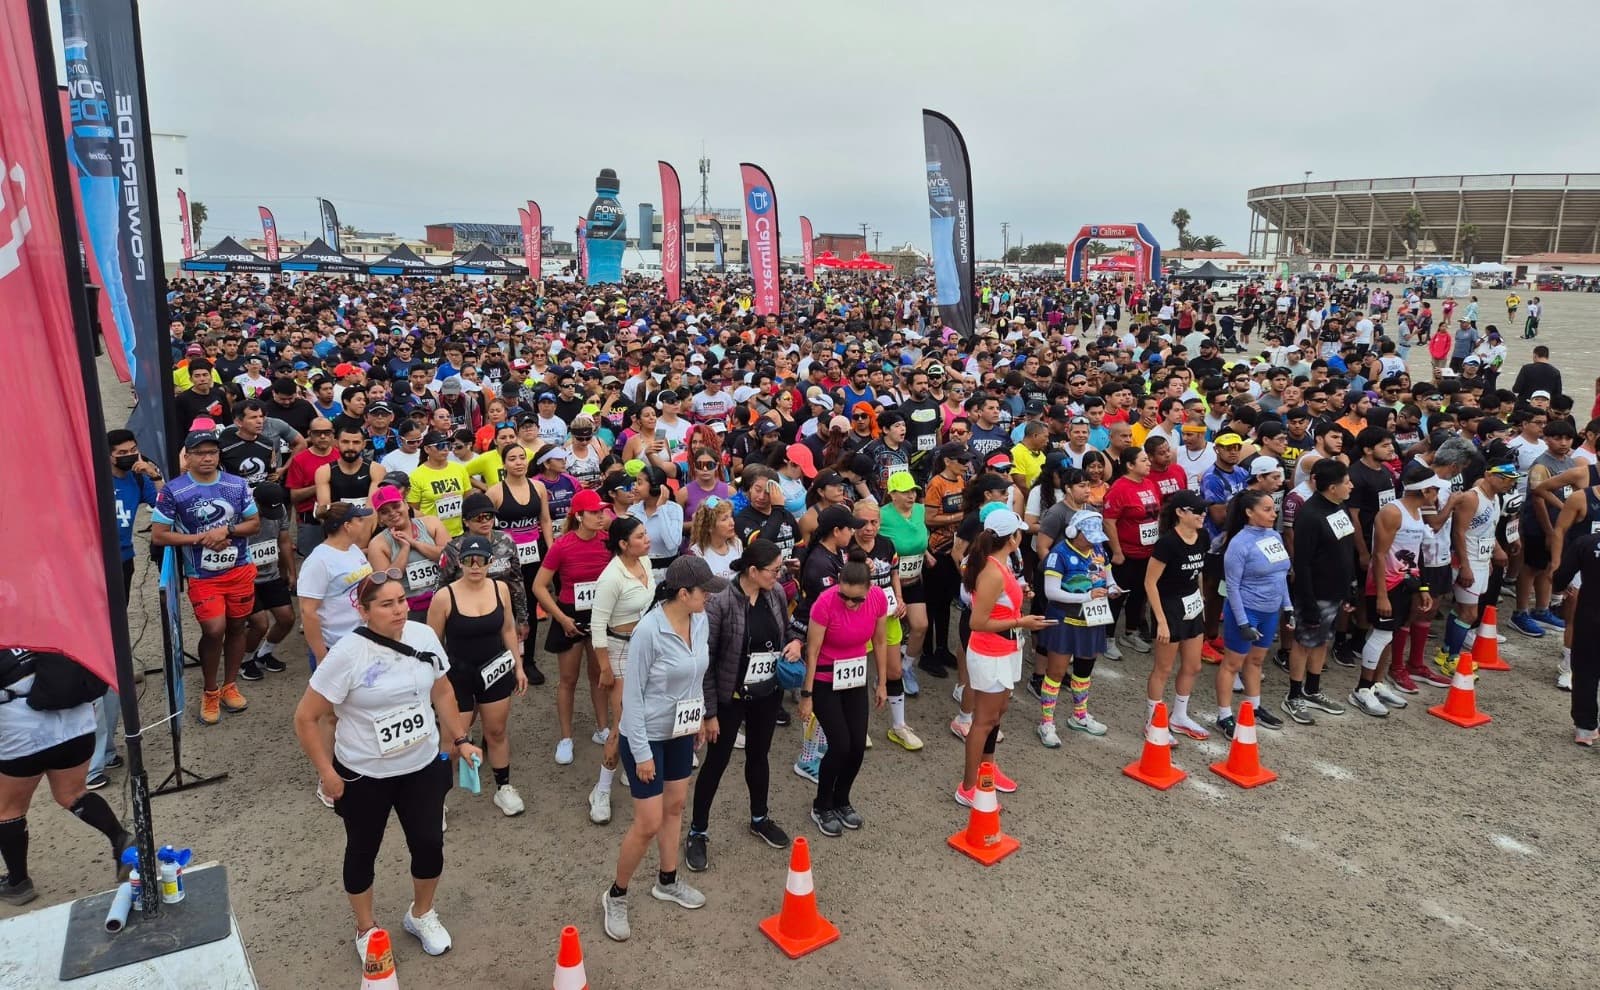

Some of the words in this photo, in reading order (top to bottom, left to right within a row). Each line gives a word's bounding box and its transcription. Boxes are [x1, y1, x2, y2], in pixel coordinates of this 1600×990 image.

[1099, 227, 1126, 236] Calimax
[431, 478, 460, 494] RUN
[438, 501, 460, 514] 0747
[252, 545, 276, 560] 1048
[519, 545, 537, 557] 789
[203, 553, 236, 563] 4366
[901, 559, 922, 572] 3287
[409, 565, 439, 581] 3350
[1086, 605, 1107, 616] 2197
[486, 659, 513, 685] 0207
[750, 661, 776, 674] 1338
[836, 666, 865, 680] 1310
[677, 707, 701, 725] 1348
[380, 713, 425, 743] 3799
